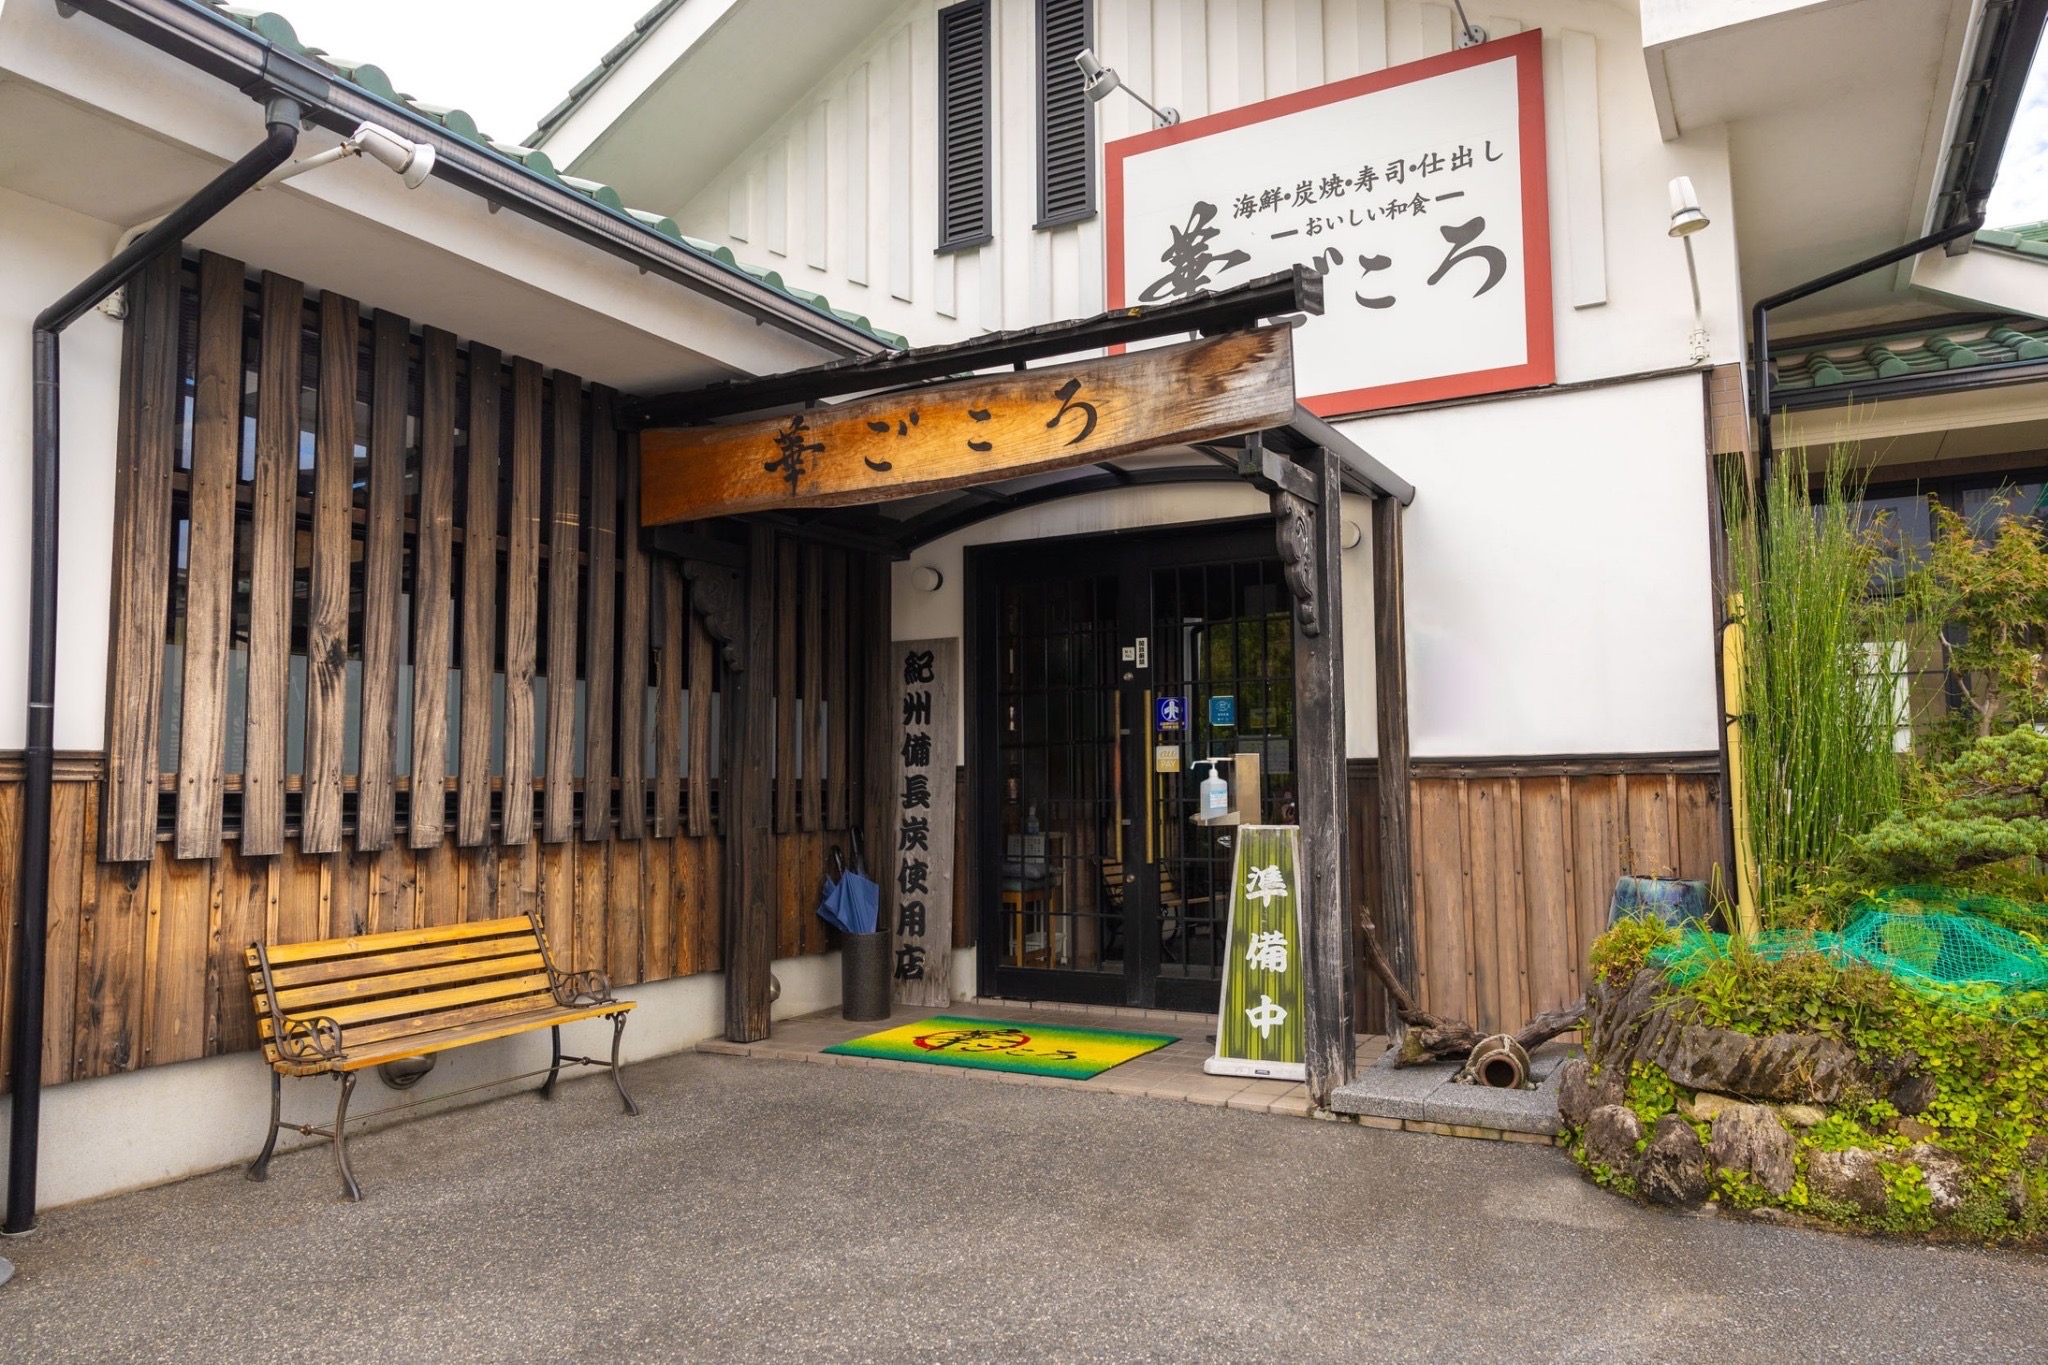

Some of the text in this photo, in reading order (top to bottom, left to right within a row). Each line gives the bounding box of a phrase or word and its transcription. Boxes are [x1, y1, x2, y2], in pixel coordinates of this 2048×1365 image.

[1233, 140, 1504, 219] 海鮮・炭焼・寿司・仕出し
[764, 377, 1099, 497] 華ごころ
[894, 650, 935, 981] 紀州備長炭使用店
[1160, 760, 1176, 768] PAY
[1245, 864, 1289, 1040] 準備中
